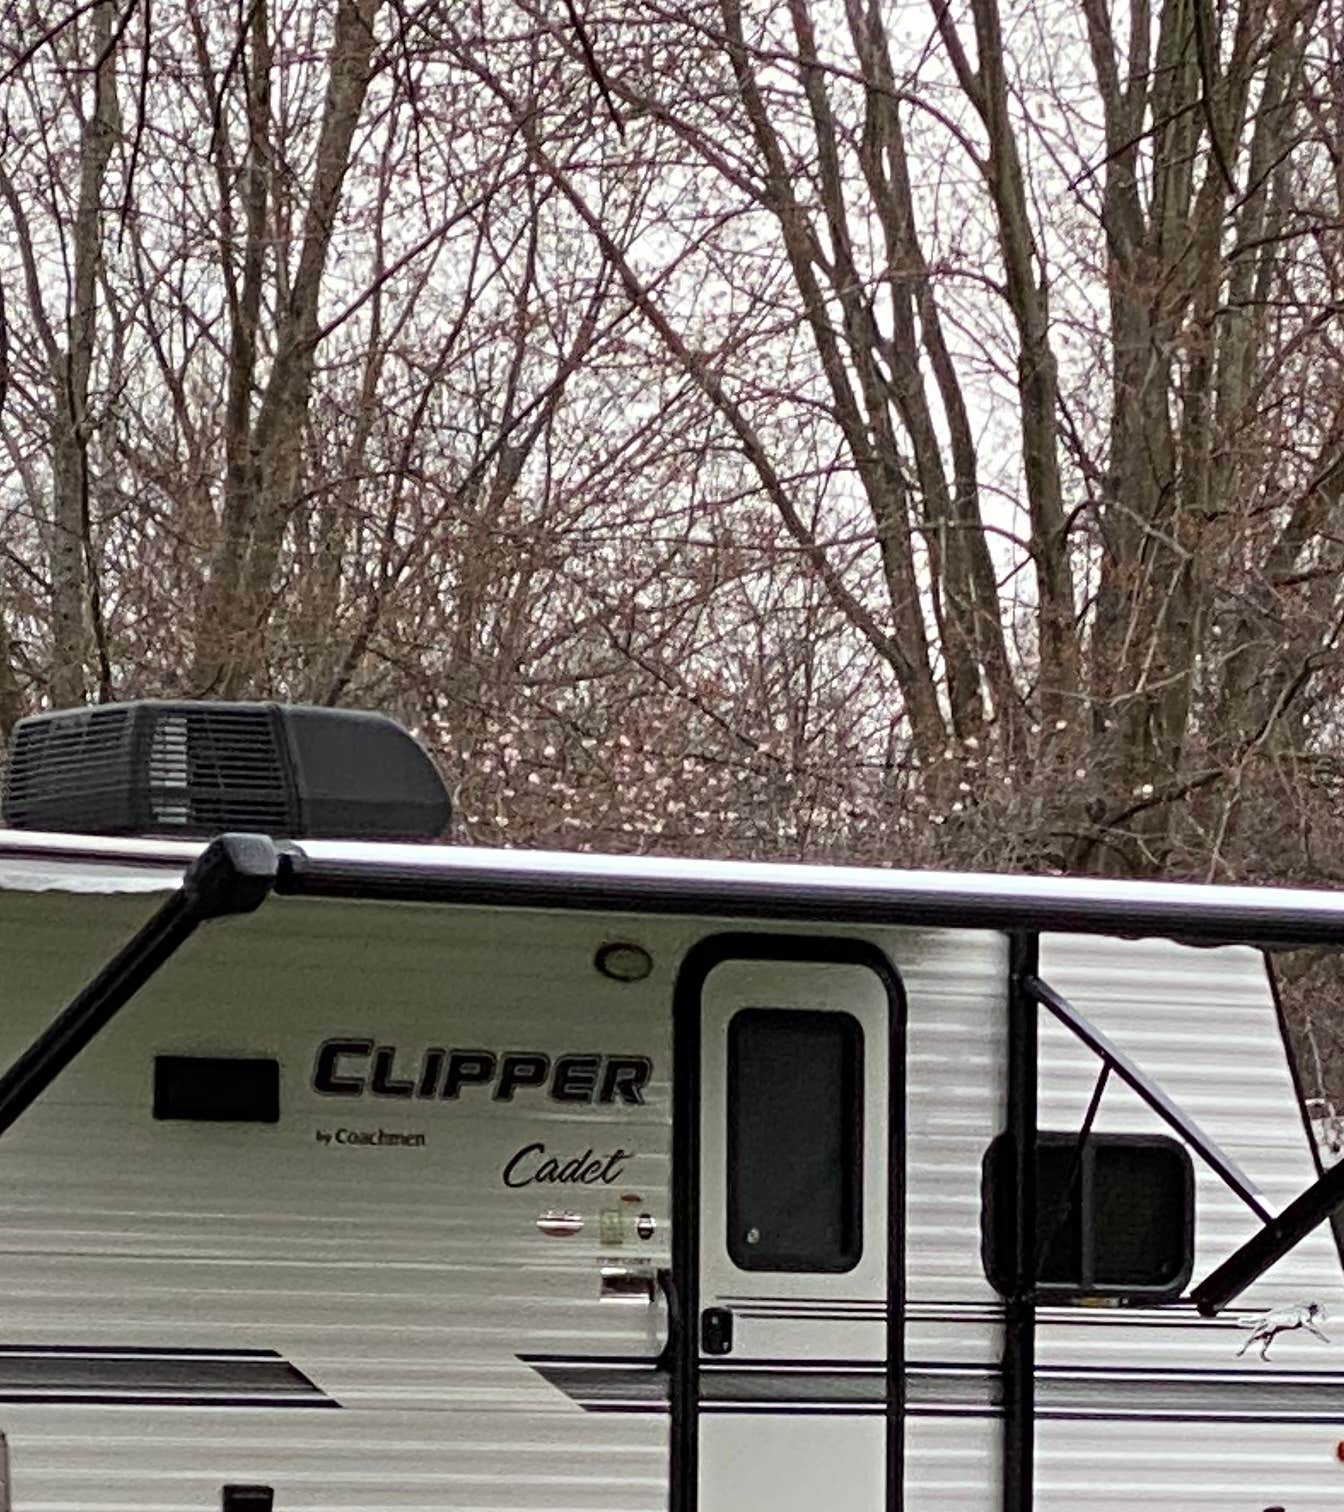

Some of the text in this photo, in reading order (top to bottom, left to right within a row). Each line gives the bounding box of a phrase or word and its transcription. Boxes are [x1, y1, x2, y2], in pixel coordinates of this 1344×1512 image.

[311, 1037, 653, 1106] CLIPPER
[315, 1127, 426, 1147] by Coachmen
[502, 1142, 635, 1188] Cadet
